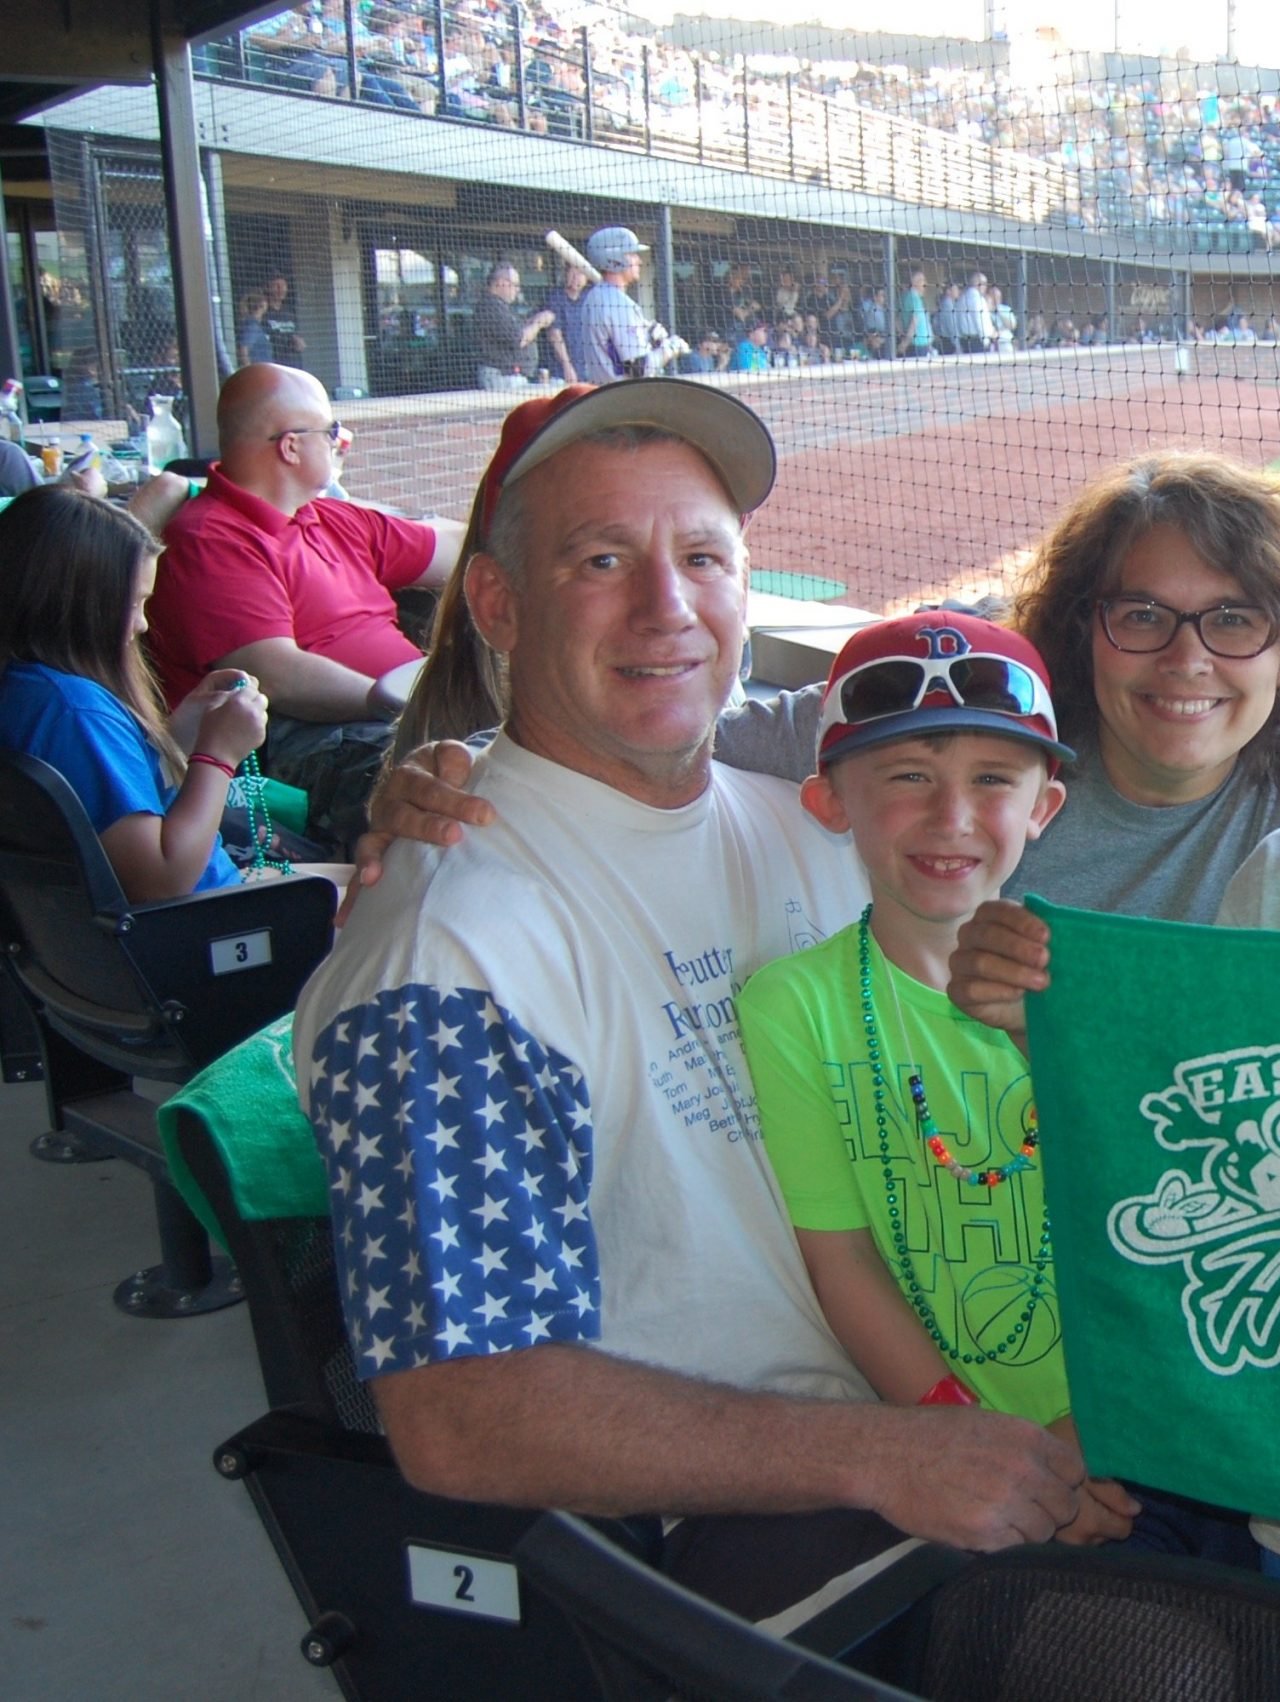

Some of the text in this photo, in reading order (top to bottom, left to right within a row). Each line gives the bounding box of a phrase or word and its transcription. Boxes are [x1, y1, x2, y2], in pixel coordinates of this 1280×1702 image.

[235, 942, 249, 963] 3
[663, 1082, 688, 1101] Tom
[671, 1093, 702, 1116] Mary
[684, 1107, 711, 1128] Meg
[453, 1564, 475, 1602] 2
